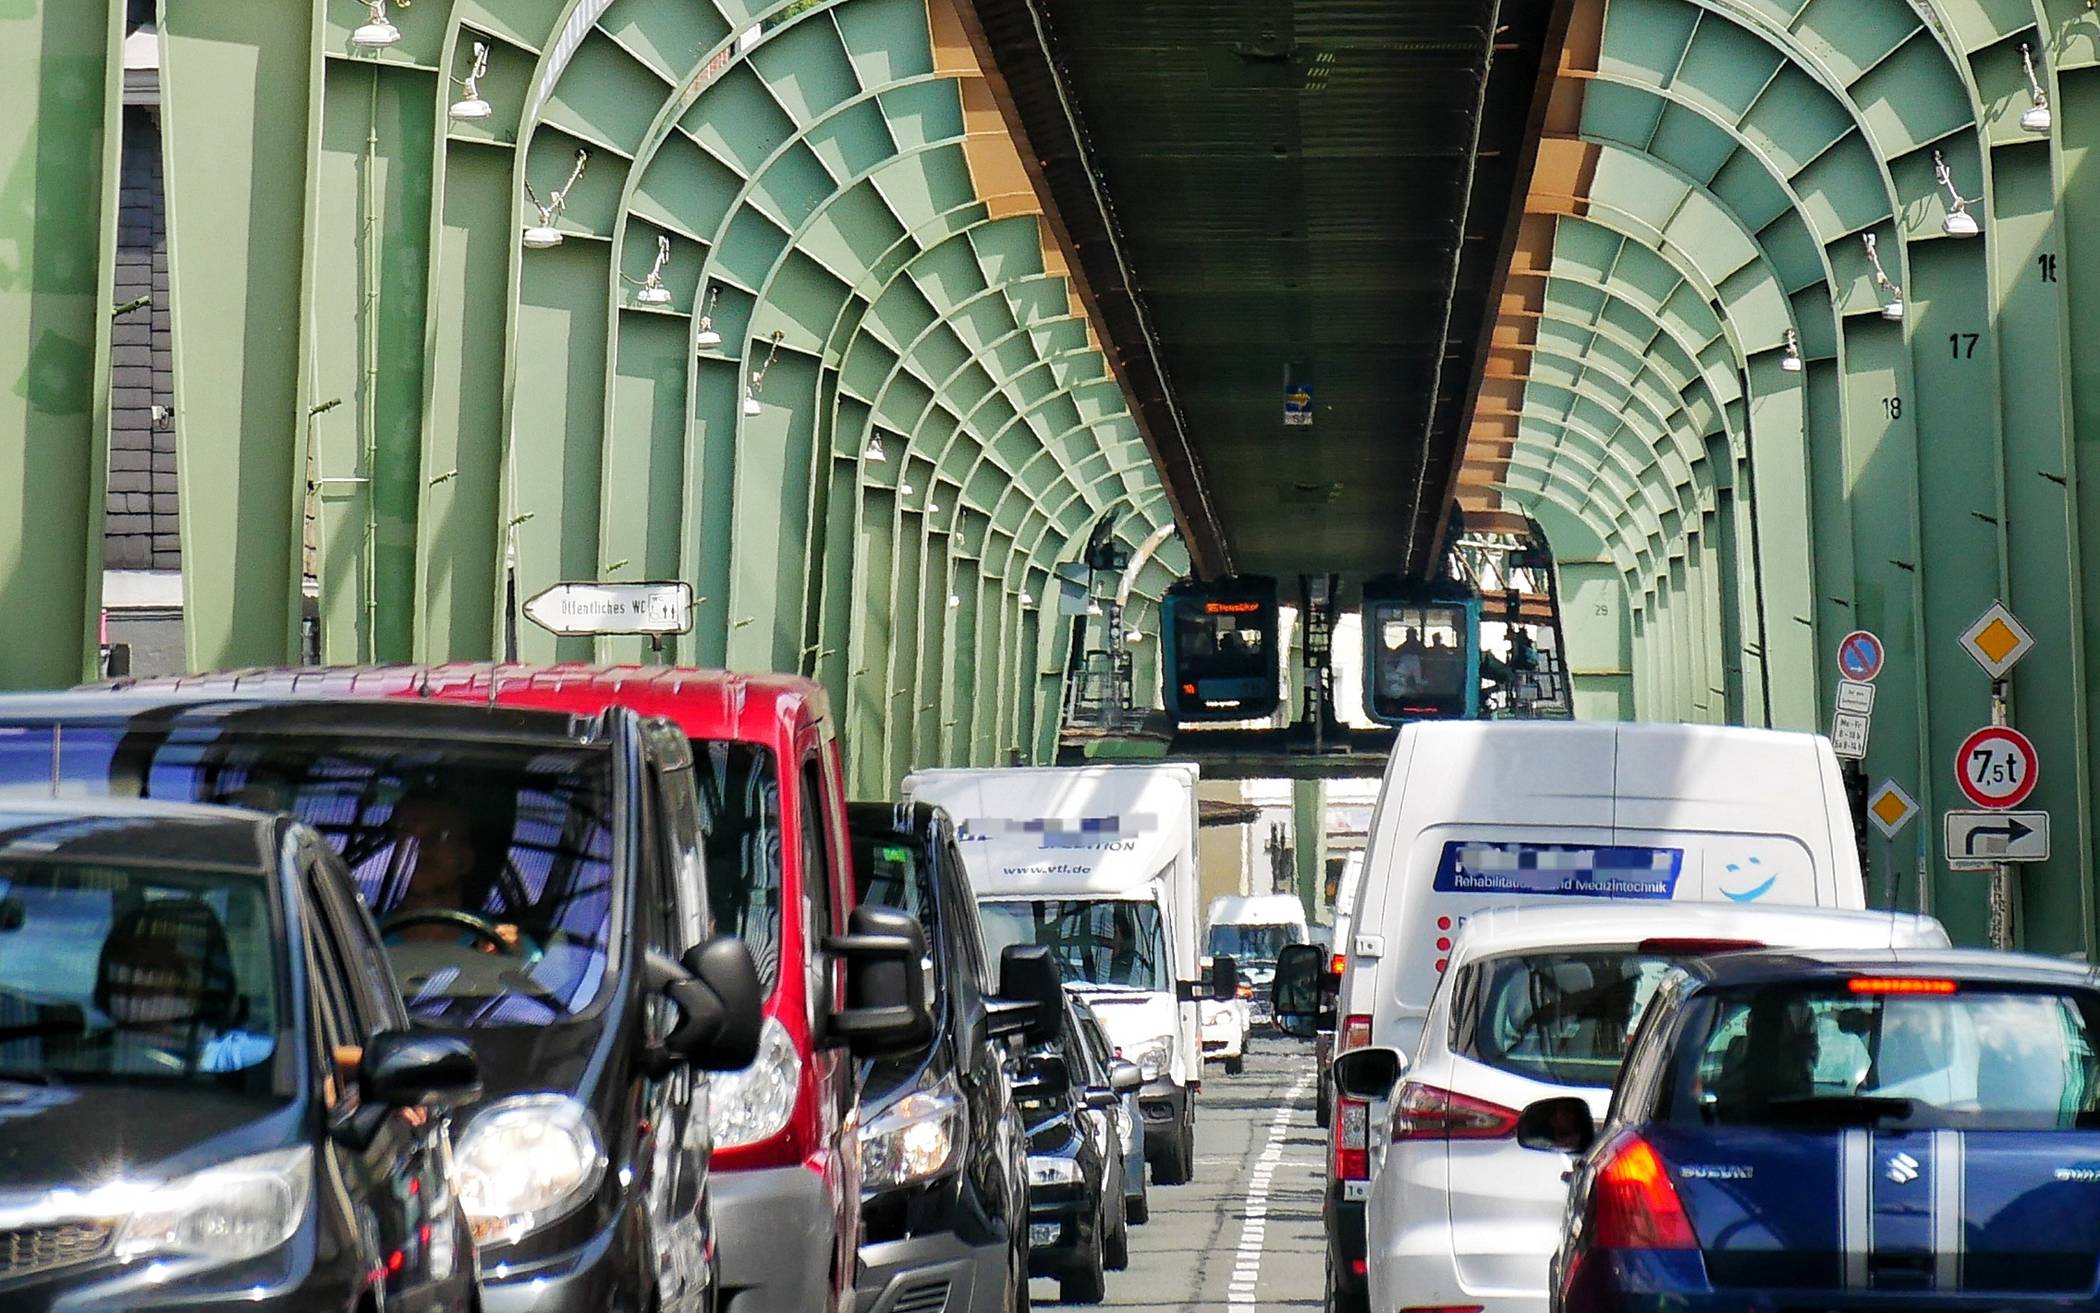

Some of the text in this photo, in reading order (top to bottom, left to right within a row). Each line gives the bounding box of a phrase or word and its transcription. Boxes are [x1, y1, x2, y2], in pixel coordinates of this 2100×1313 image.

[1949, 333, 1980, 359] 17
[1882, 397, 1901, 420] 18
[561, 599, 646, 615] Öffentliches WC
[1575, 880, 1667, 893] Medizintechnik
